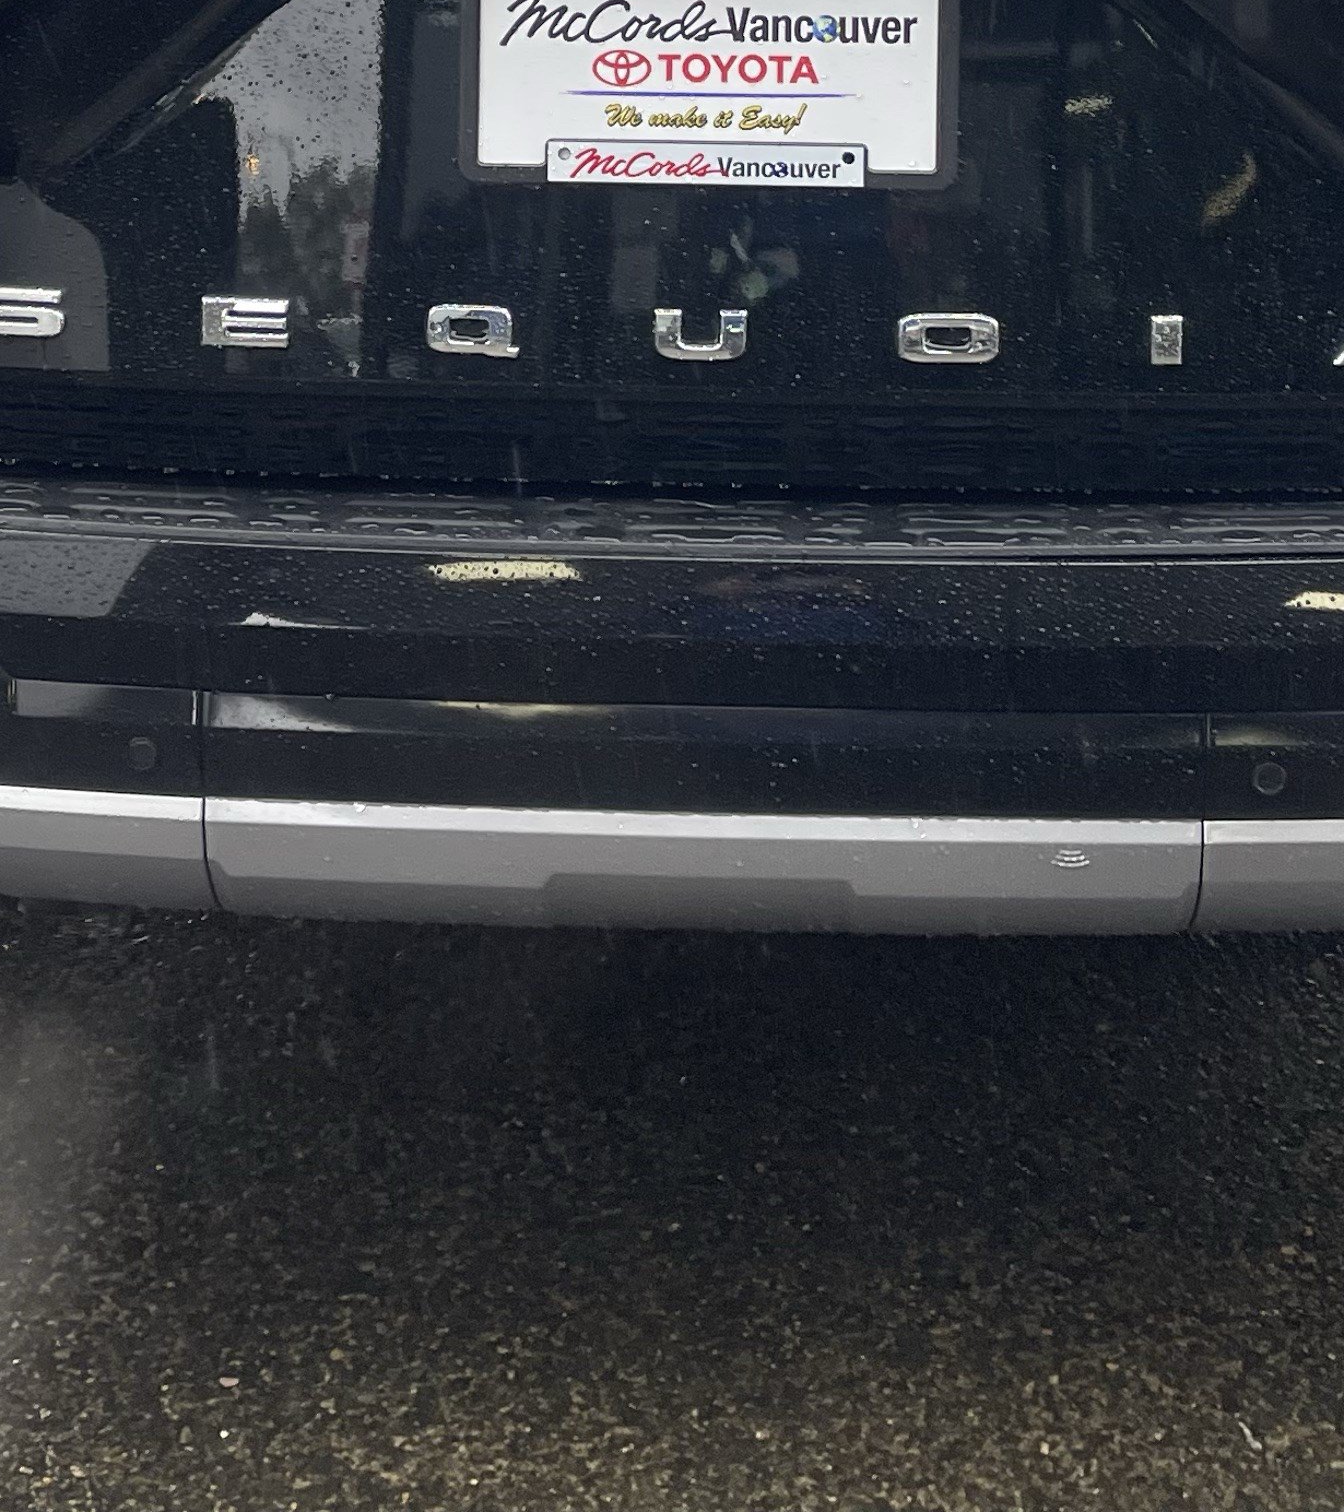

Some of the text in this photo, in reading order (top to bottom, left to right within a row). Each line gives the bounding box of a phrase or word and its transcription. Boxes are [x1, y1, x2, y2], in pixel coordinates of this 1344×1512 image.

[726, 6, 918, 44] Vancouver
[658, 53, 819, 85] TOYOTA
[604, 103, 808, 134] We make it Easy!
[569, 148, 842, 180] McCords Vancouver
